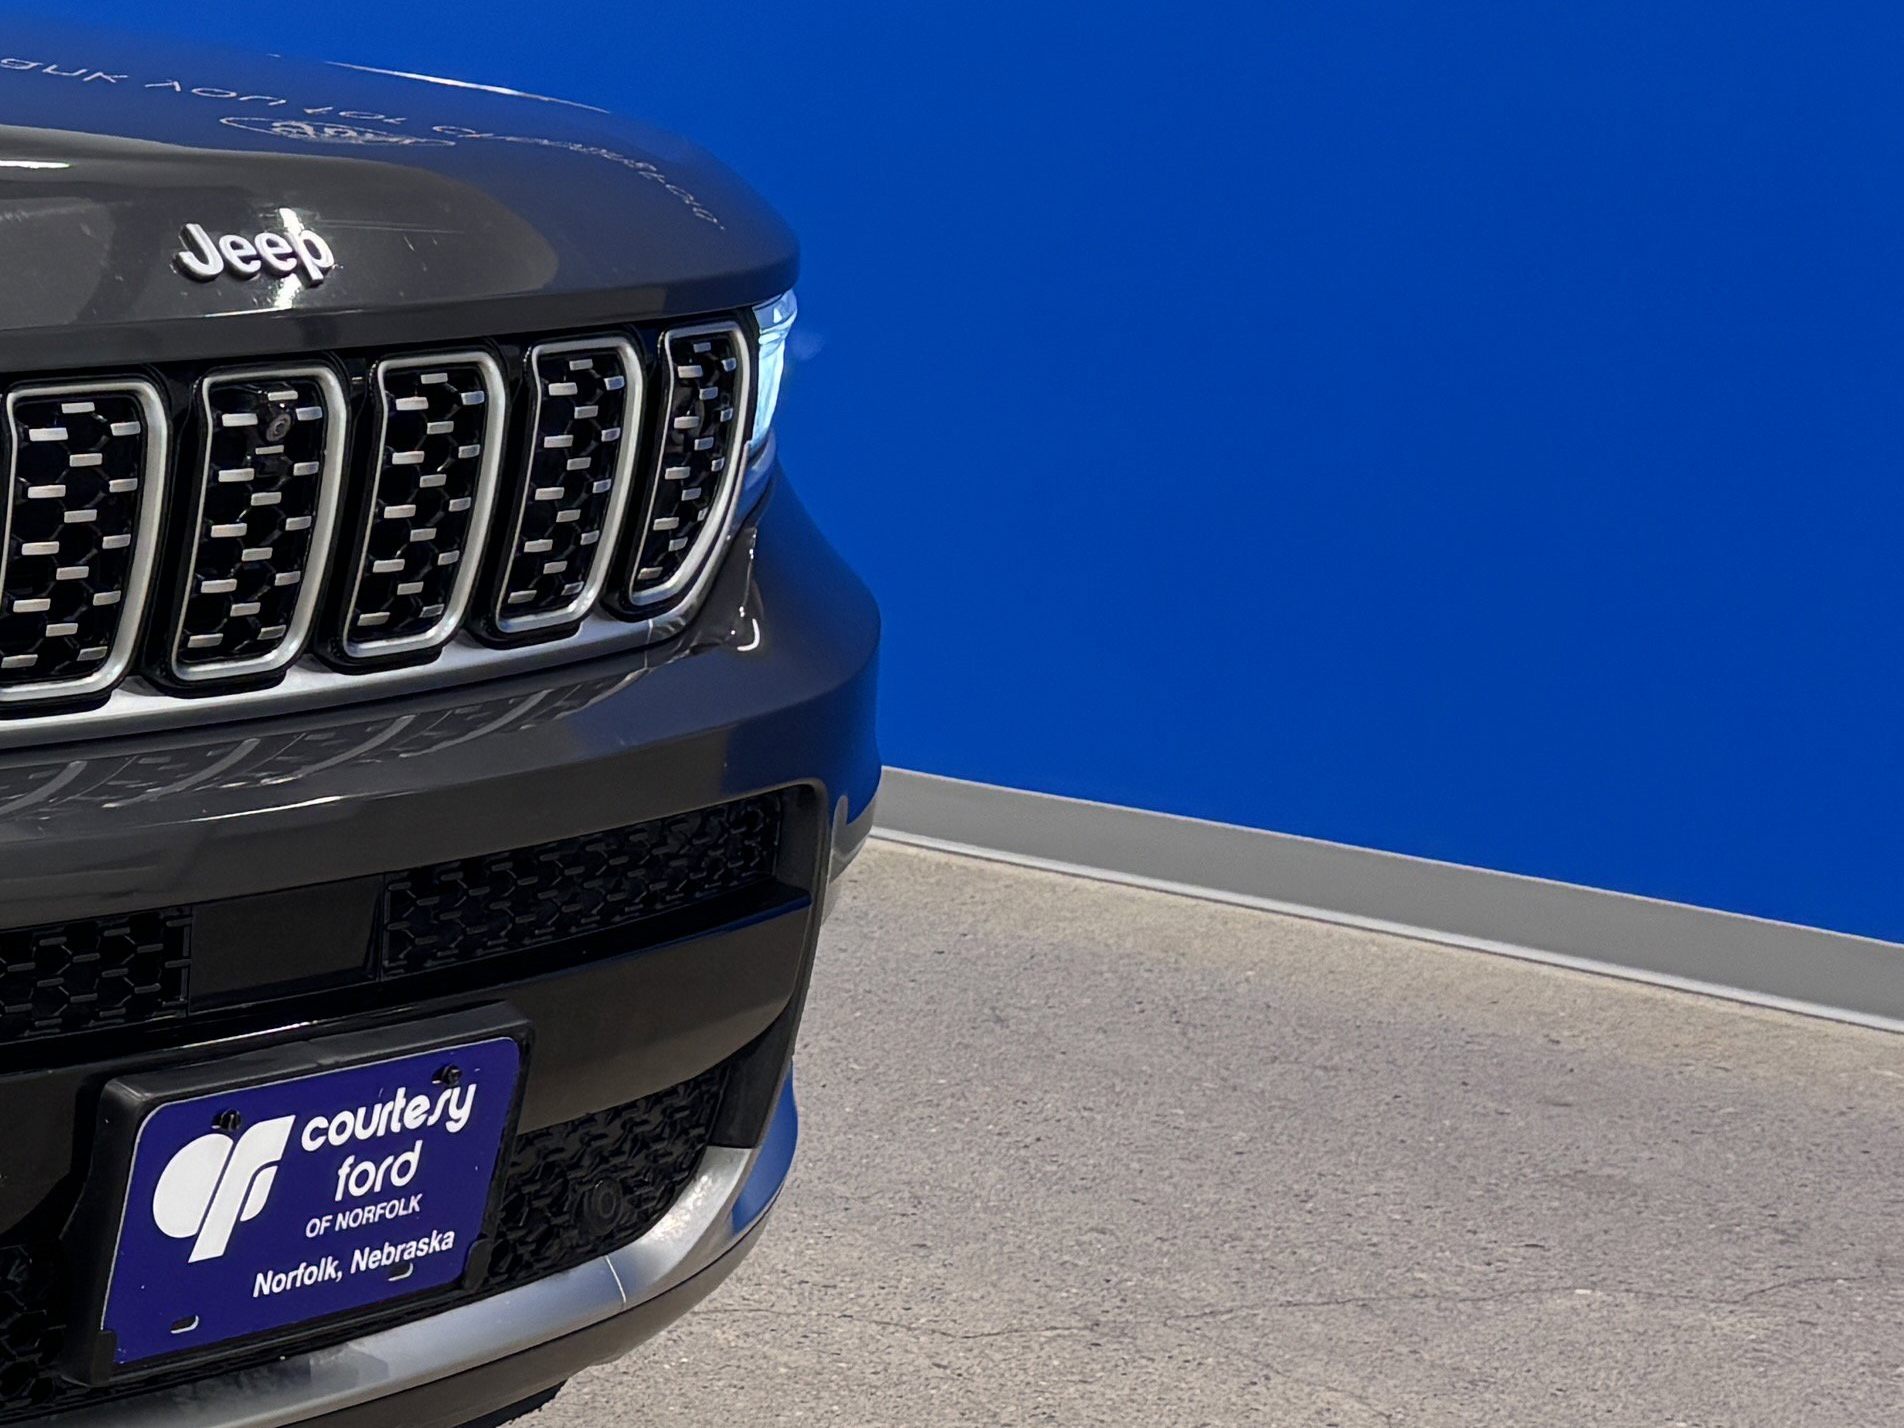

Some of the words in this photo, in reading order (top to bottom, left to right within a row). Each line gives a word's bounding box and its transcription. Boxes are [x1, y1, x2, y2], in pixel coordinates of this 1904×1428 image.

[175, 222, 335, 282] Jeep
[301, 1083, 477, 1152] courtesy
[335, 1139, 423, 1202] ford
[305, 1215, 333, 1238] OF
[335, 1193, 423, 1231] NORFOLK
[252, 1256, 343, 1298] Norfolk,
[350, 1229, 455, 1274] Nebraska
